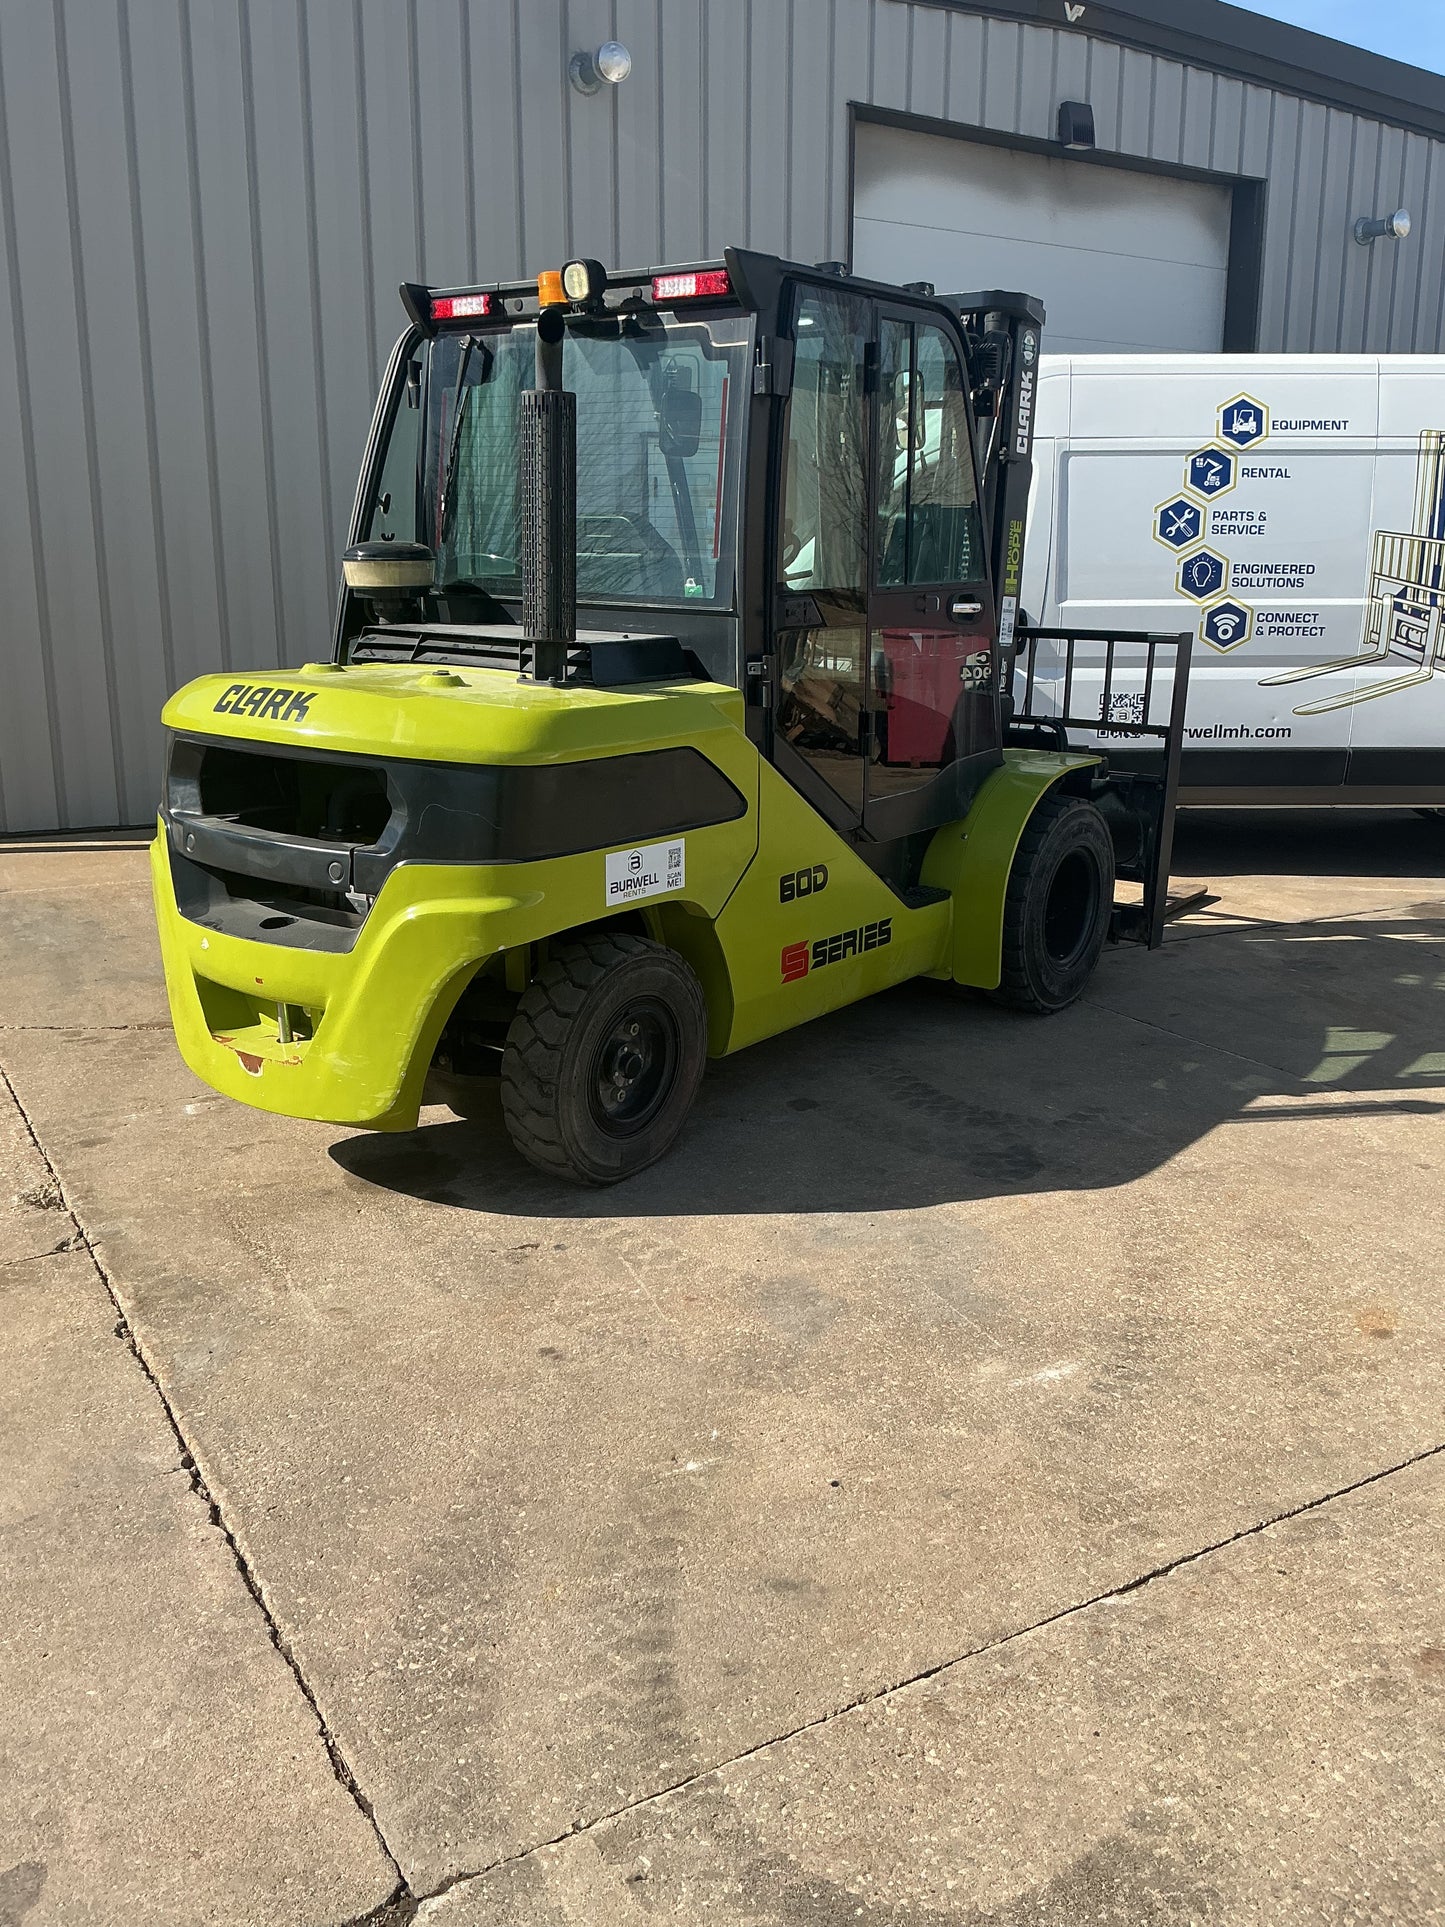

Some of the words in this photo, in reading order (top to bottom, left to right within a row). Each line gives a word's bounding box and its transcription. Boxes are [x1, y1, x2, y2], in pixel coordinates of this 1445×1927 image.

[1016, 370, 1033, 455] CLARK
[1271, 420, 1349, 431] EQUIPMENT
[1241, 468, 1291, 478] RENTAL
[1212, 511, 1254, 521] PARTS
[1258, 511, 1267, 521] &
[1211, 525, 1266, 535] SERVICE
[1005, 521, 1022, 585] HOPE
[1233, 564, 1315, 574] ENGINEERED
[1231, 578, 1304, 588] SOLUTIONS
[1256, 613, 1319, 623] CONNECT
[1255, 626, 1264, 636] &
[1268, 627, 1326, 637] PROTECT
[213, 684, 319, 722] CLARK
[667, 871, 682, 880] SCAN
[610, 873, 659, 894] BURWELL
[667, 878, 682, 888] ME!
[779, 864, 829, 904] 60D
[623, 887, 647, 899] RENTS
[810, 917, 893, 970] SERIES
